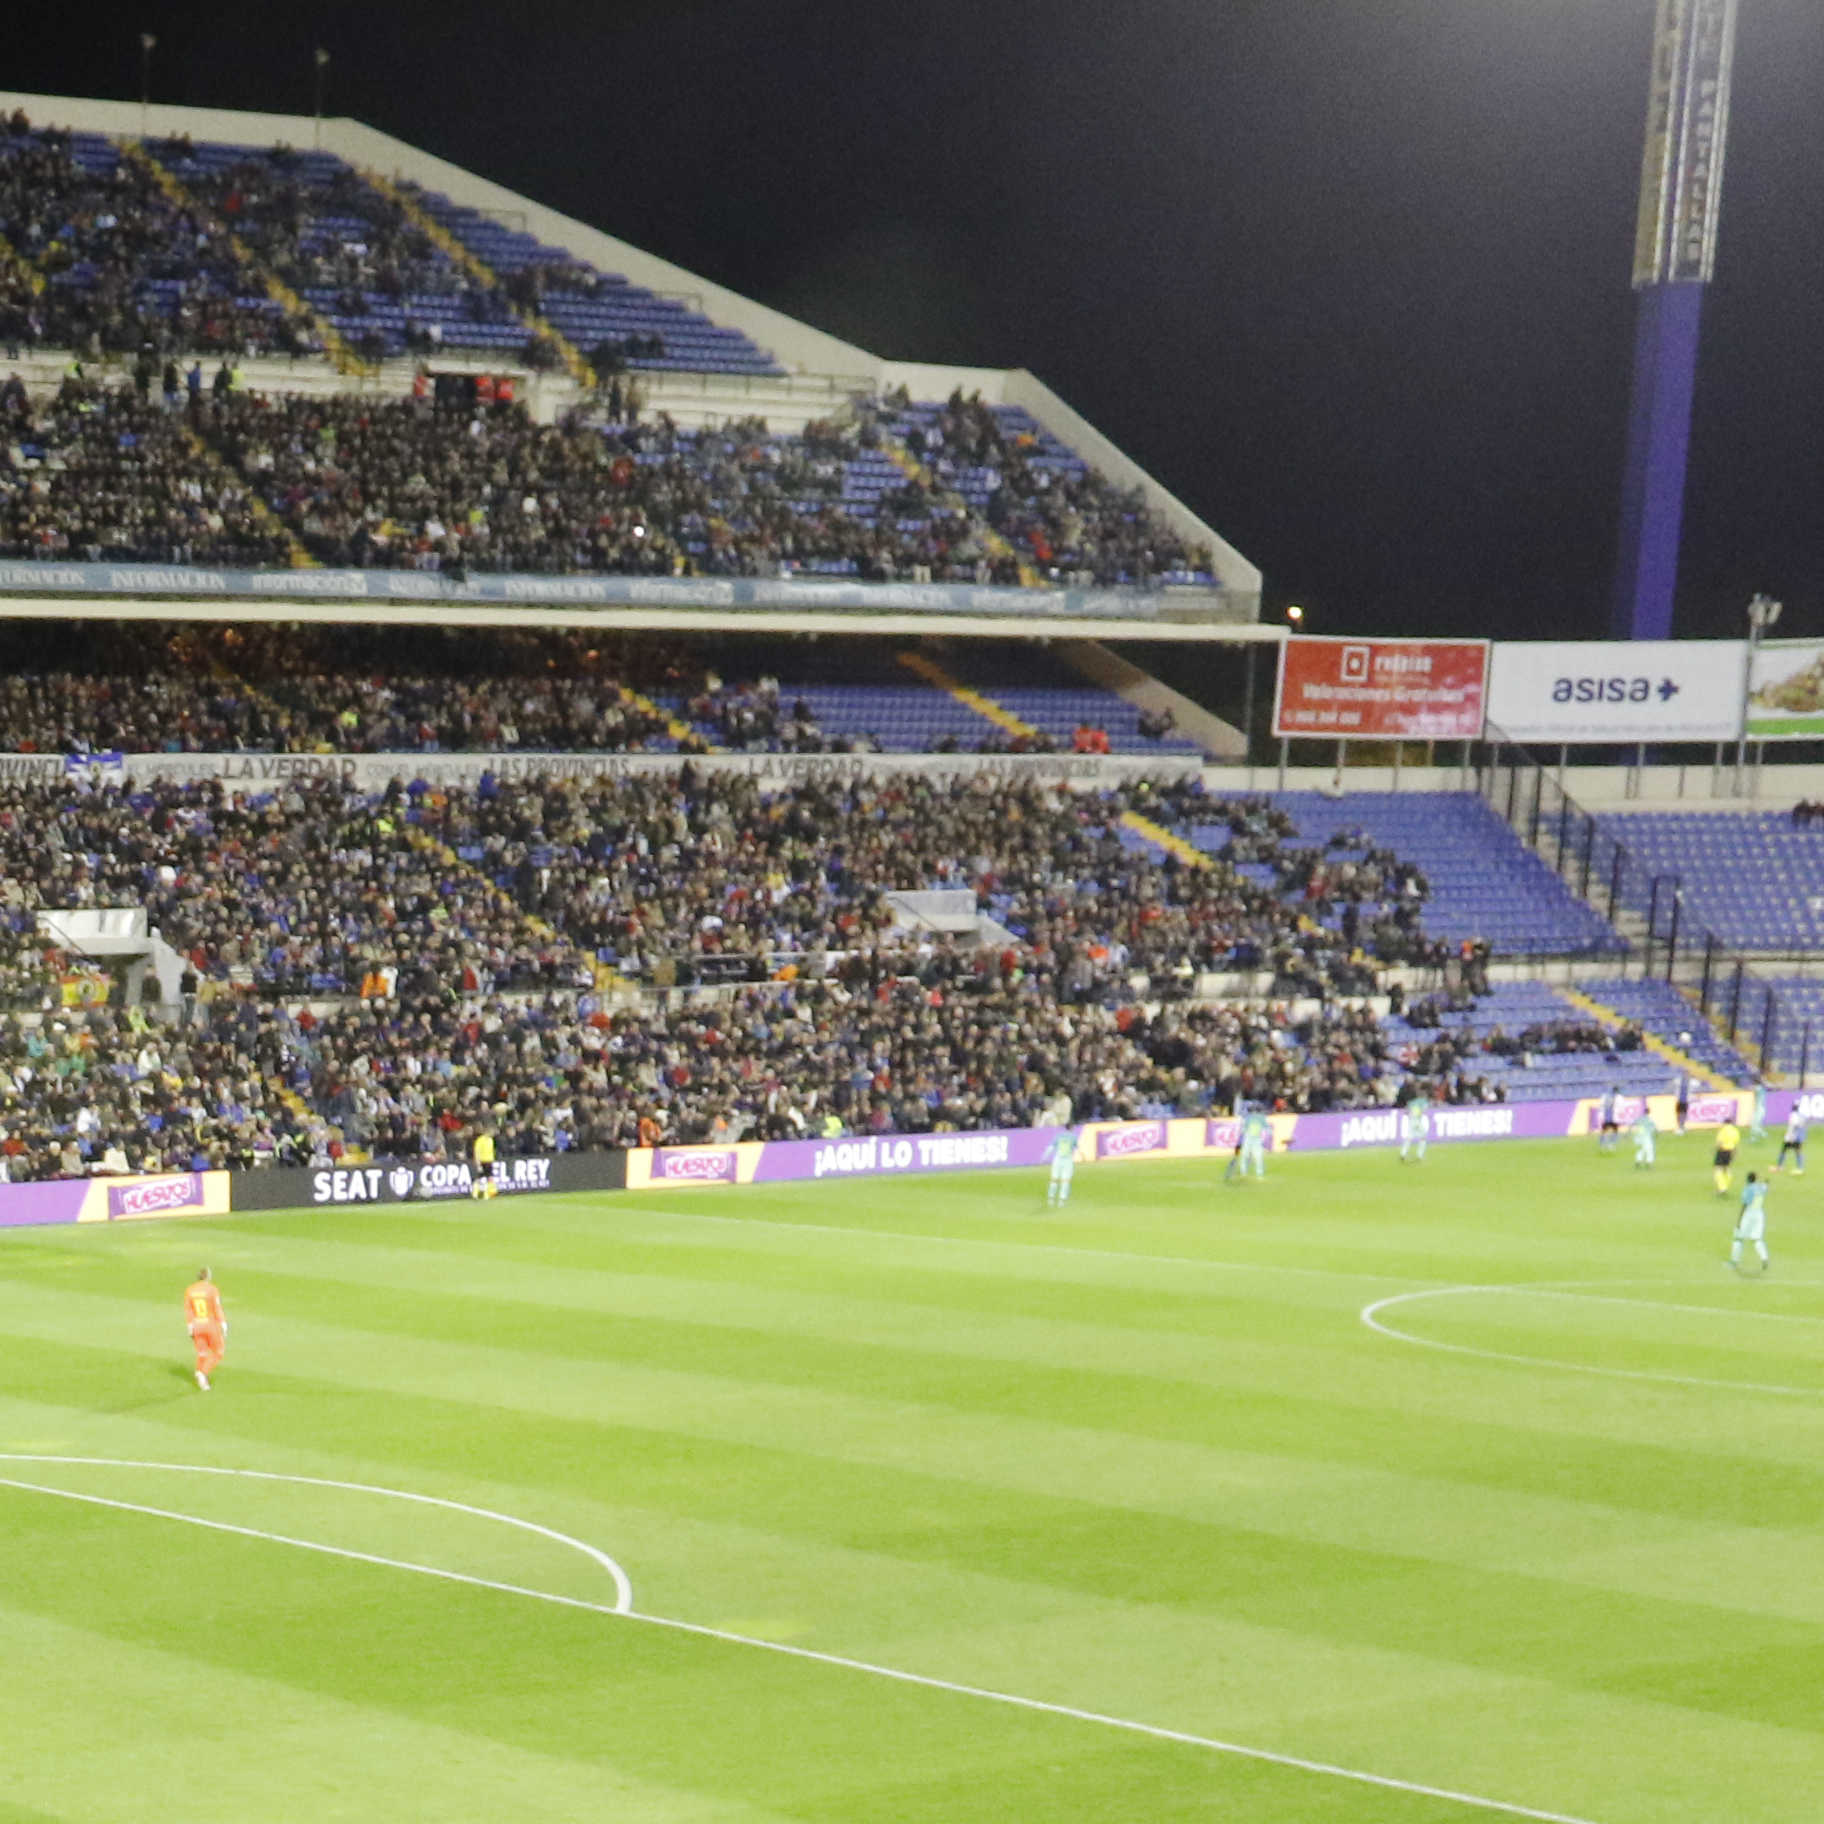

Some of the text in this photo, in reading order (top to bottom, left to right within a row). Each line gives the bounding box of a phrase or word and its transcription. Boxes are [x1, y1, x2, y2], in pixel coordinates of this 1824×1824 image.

[1552, 677, 1651, 702] asisa
[1433, 1109, 1512, 1137] TIENES!
[815, 1135, 1008, 1176] ¡AQUÍ LO TIENES!
[313, 1168, 383, 1201] SEAT
[419, 1163, 472, 1188] COPA
[491, 1159, 511, 1183] EL
[513, 1157, 551, 1181] REY
